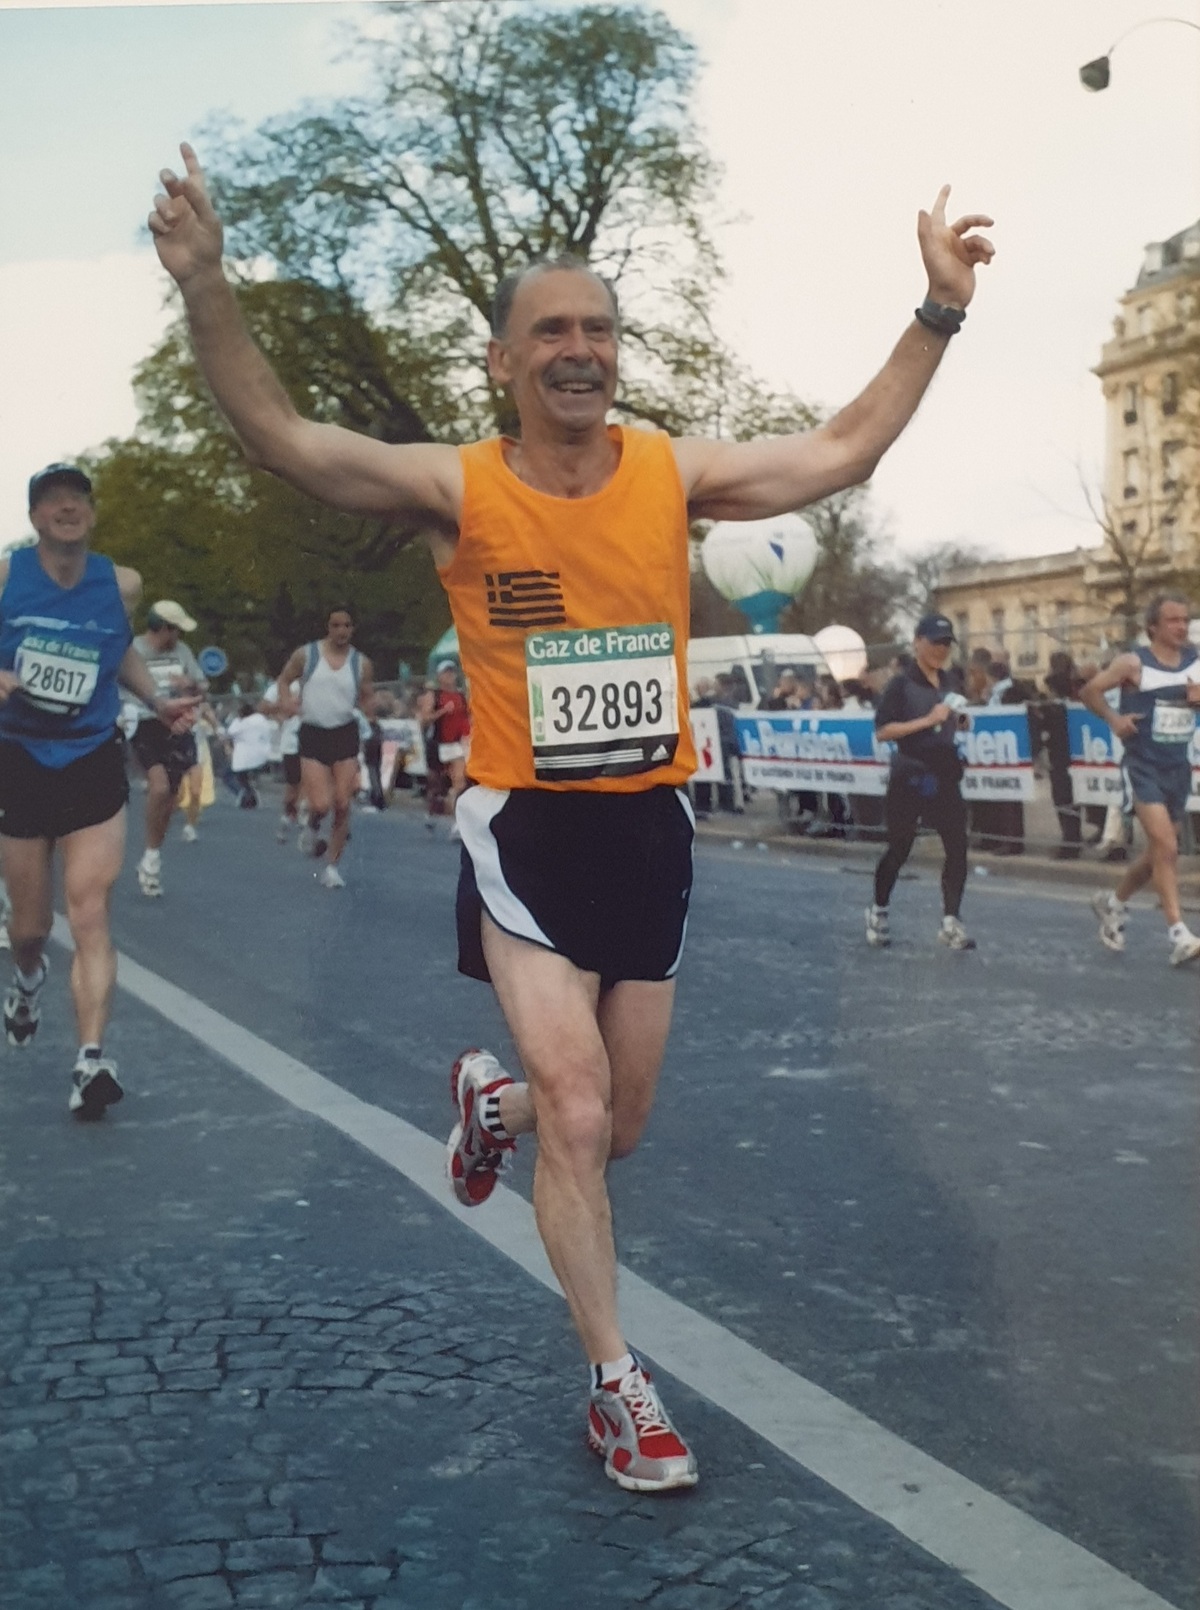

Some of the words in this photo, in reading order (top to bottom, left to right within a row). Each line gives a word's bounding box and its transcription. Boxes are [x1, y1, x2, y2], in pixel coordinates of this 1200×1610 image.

[528, 637, 571, 659] Gaz
[574, 634, 601, 656] de
[606, 631, 671, 654] France
[26, 662, 87, 697] 28617
[551, 678, 663, 734] 32893
